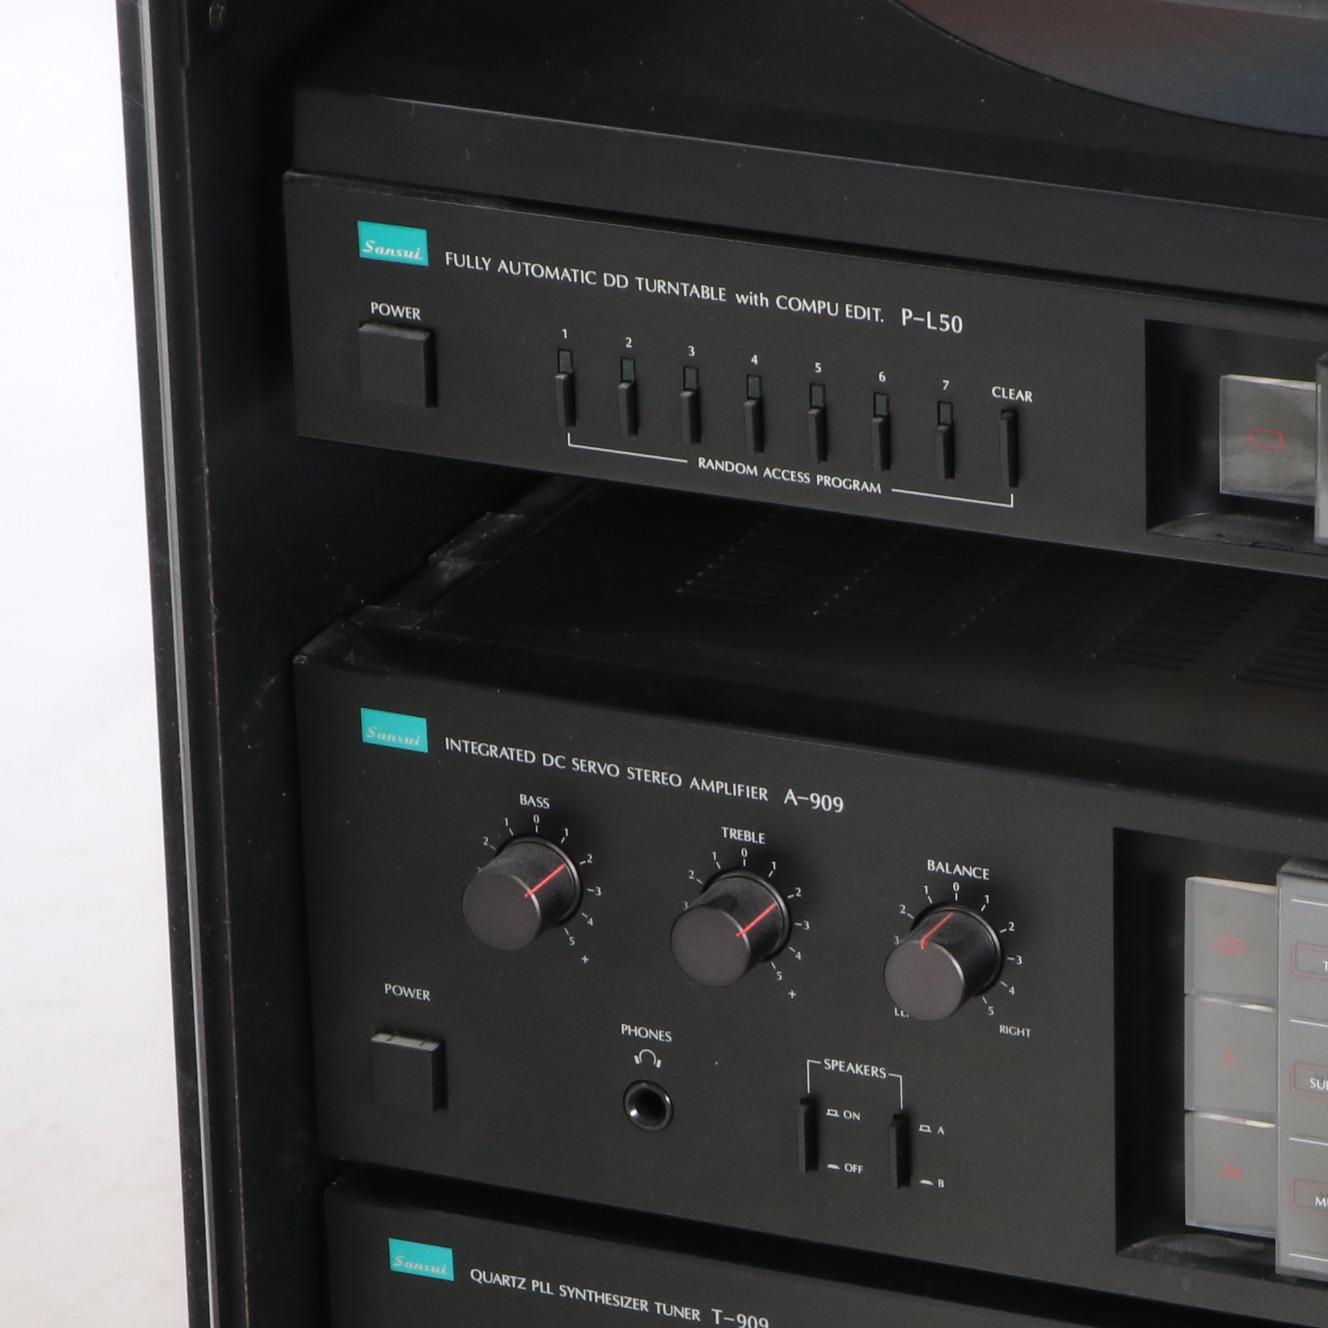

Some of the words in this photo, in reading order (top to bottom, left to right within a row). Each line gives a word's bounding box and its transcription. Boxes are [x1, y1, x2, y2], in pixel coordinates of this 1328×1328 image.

[363, 237, 425, 263] Sansui
[445, 250, 492, 272] FULLY
[497, 258, 598, 285] AUTOMATIC
[603, 273, 629, 289] DD
[635, 277, 727, 302] TURNTABLE
[735, 290, 770, 308] with
[775, 294, 839, 317] COMPU
[845, 303, 884, 323] EDIT.
[901, 307, 964, 334] P-L50
[370, 302, 421, 321] POWER
[991, 385, 1032, 403] CLEAR
[697, 456, 758, 478] RANDOM
[763, 467, 811, 485] ACCESS
[815, 475, 881, 494] PROGRAM
[365, 725, 421, 747] Sansui
[444, 737, 536, 765] INTEGRATED
[542, 753, 566, 769] DC
[571, 757, 620, 778] SERVO
[627, 767, 682, 787] STEREO
[689, 777, 768, 802] AMPLIFIER
[784, 789, 844, 813] A-909
[520, 794, 550, 809] BASS
[721, 827, 765, 844] TREBLE
[926, 859, 990, 880] BALANCE
[384, 984, 431, 1001] POWER
[620, 1024, 673, 1043] PHONES
[999, 1025, 1031, 1037] RIGHT
[823, 1059, 887, 1079] SPEAKERS
[394, 1255, 449, 1277] Sansui
[470, 1268, 526, 1290] QUARTZ
[531, 1278, 554, 1295] PLL
[558, 1284, 649, 1312] SYNTHESIZER
[654, 1302, 700, 1321] TUNER
